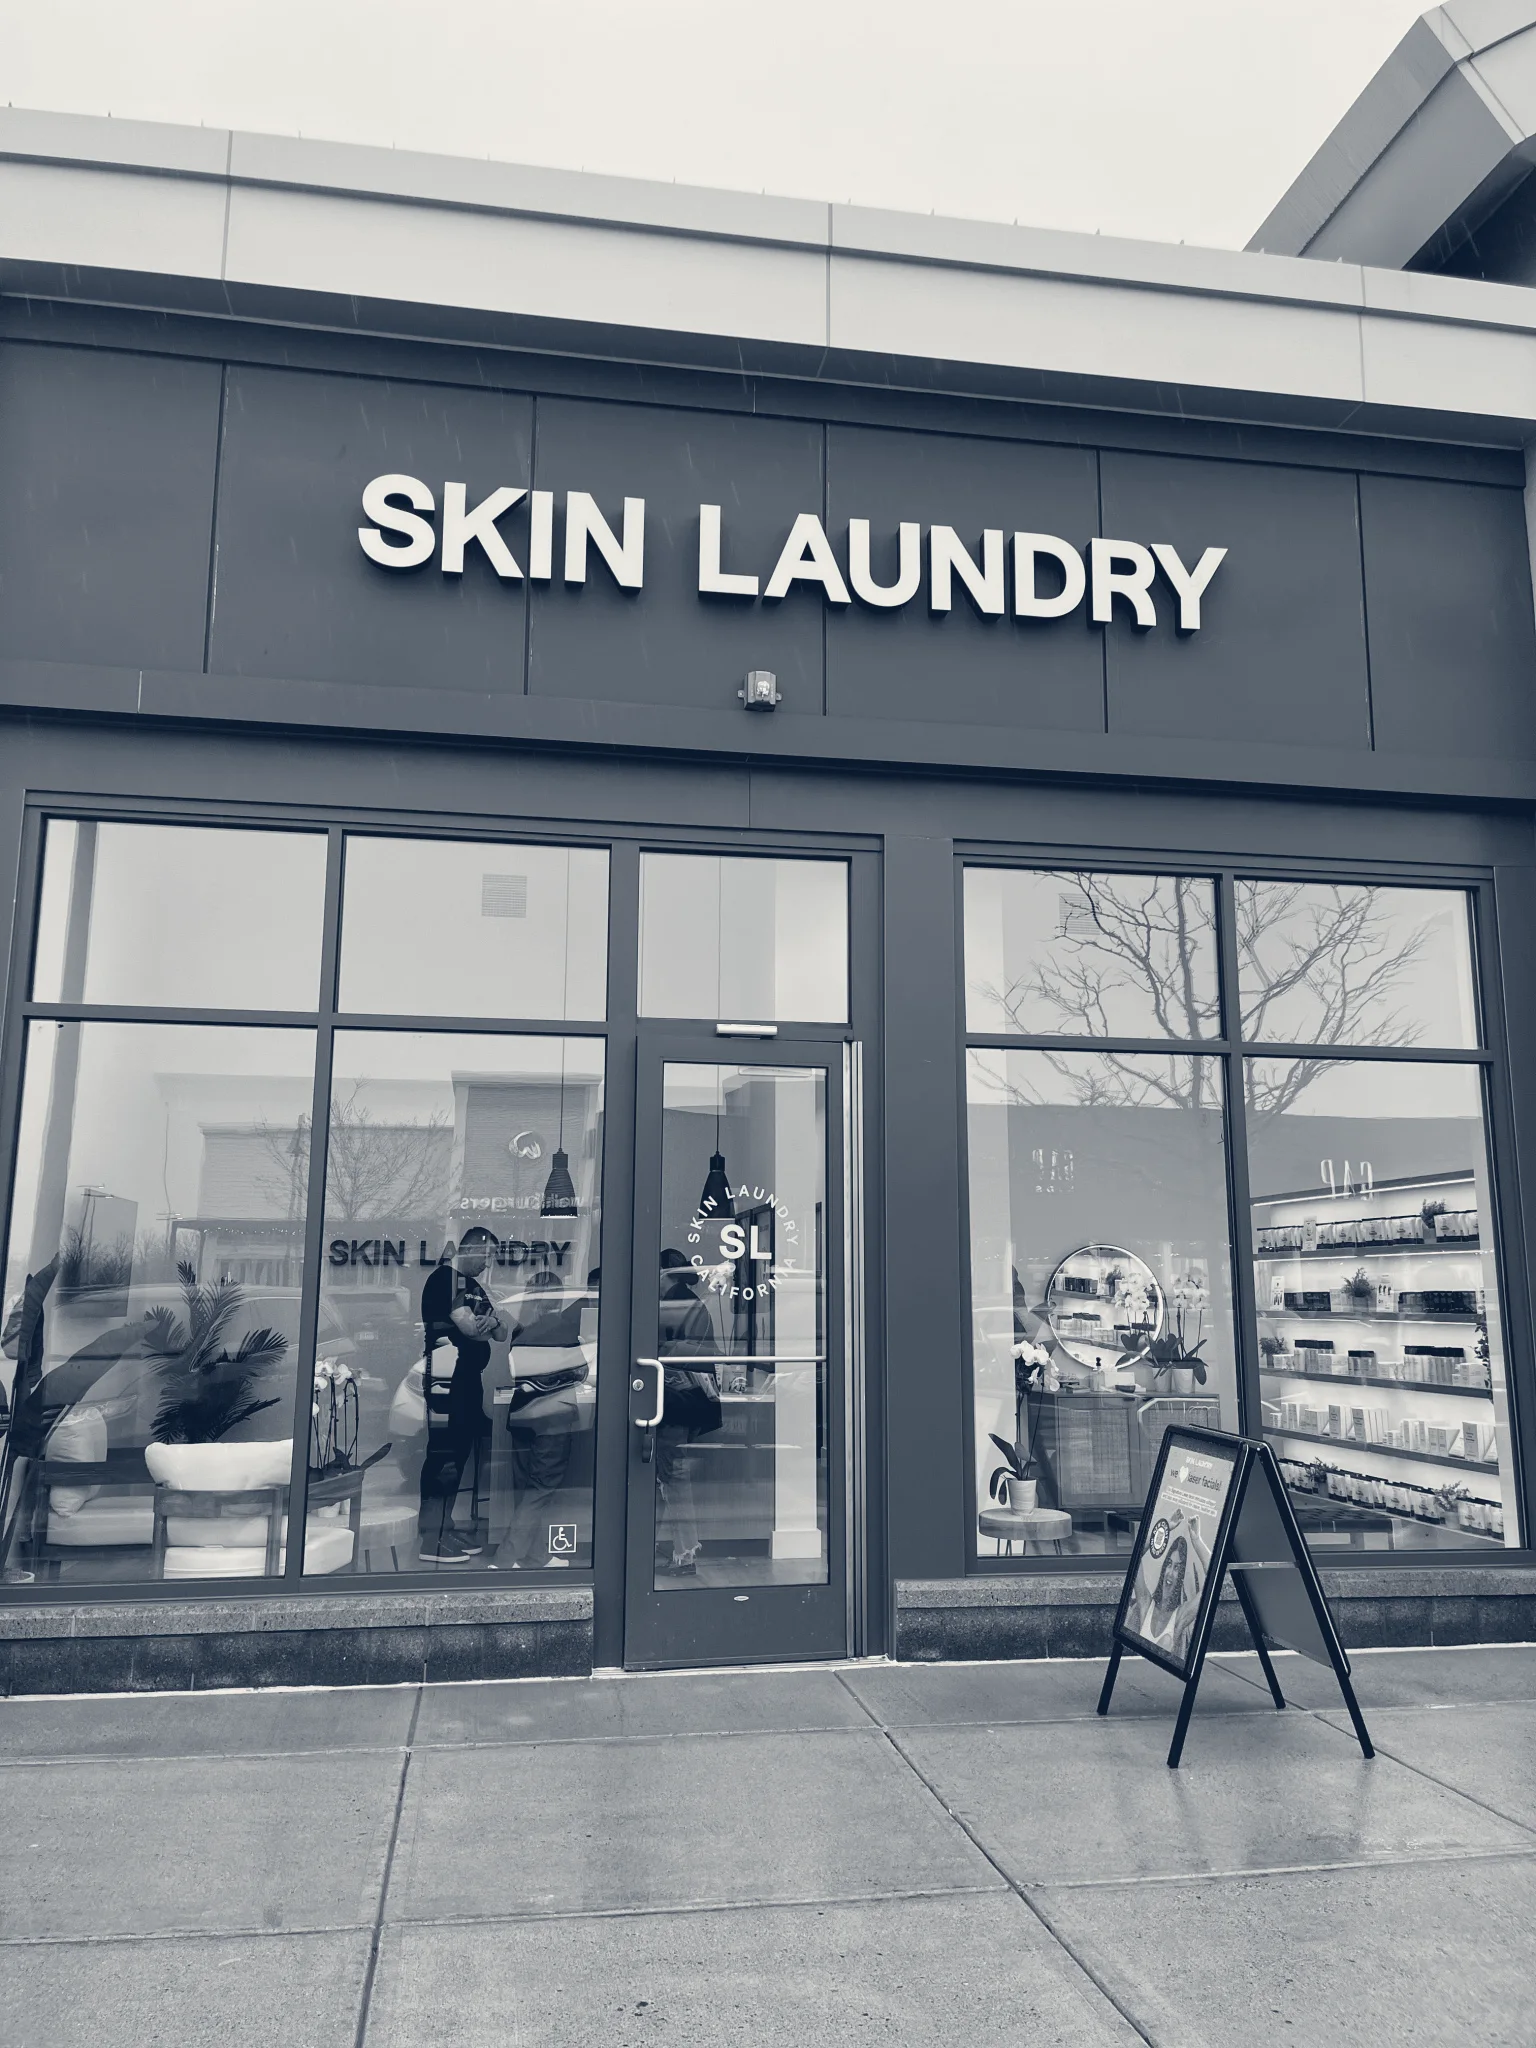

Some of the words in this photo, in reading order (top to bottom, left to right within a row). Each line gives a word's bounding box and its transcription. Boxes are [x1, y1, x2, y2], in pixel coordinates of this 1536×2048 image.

[358, 473, 645, 590] SKIN
[697, 504, 1228, 632] LAUNDRY
[687, 1195, 719, 1244] SKIN
[724, 1184, 799, 1246] LAUNDRY
[328, 1239, 406, 1267] SKIN
[419, 1239, 572, 1267] LANDRY
[718, 1223, 773, 1260] SL
[690, 1254, 797, 1301] CALIFORNIA
